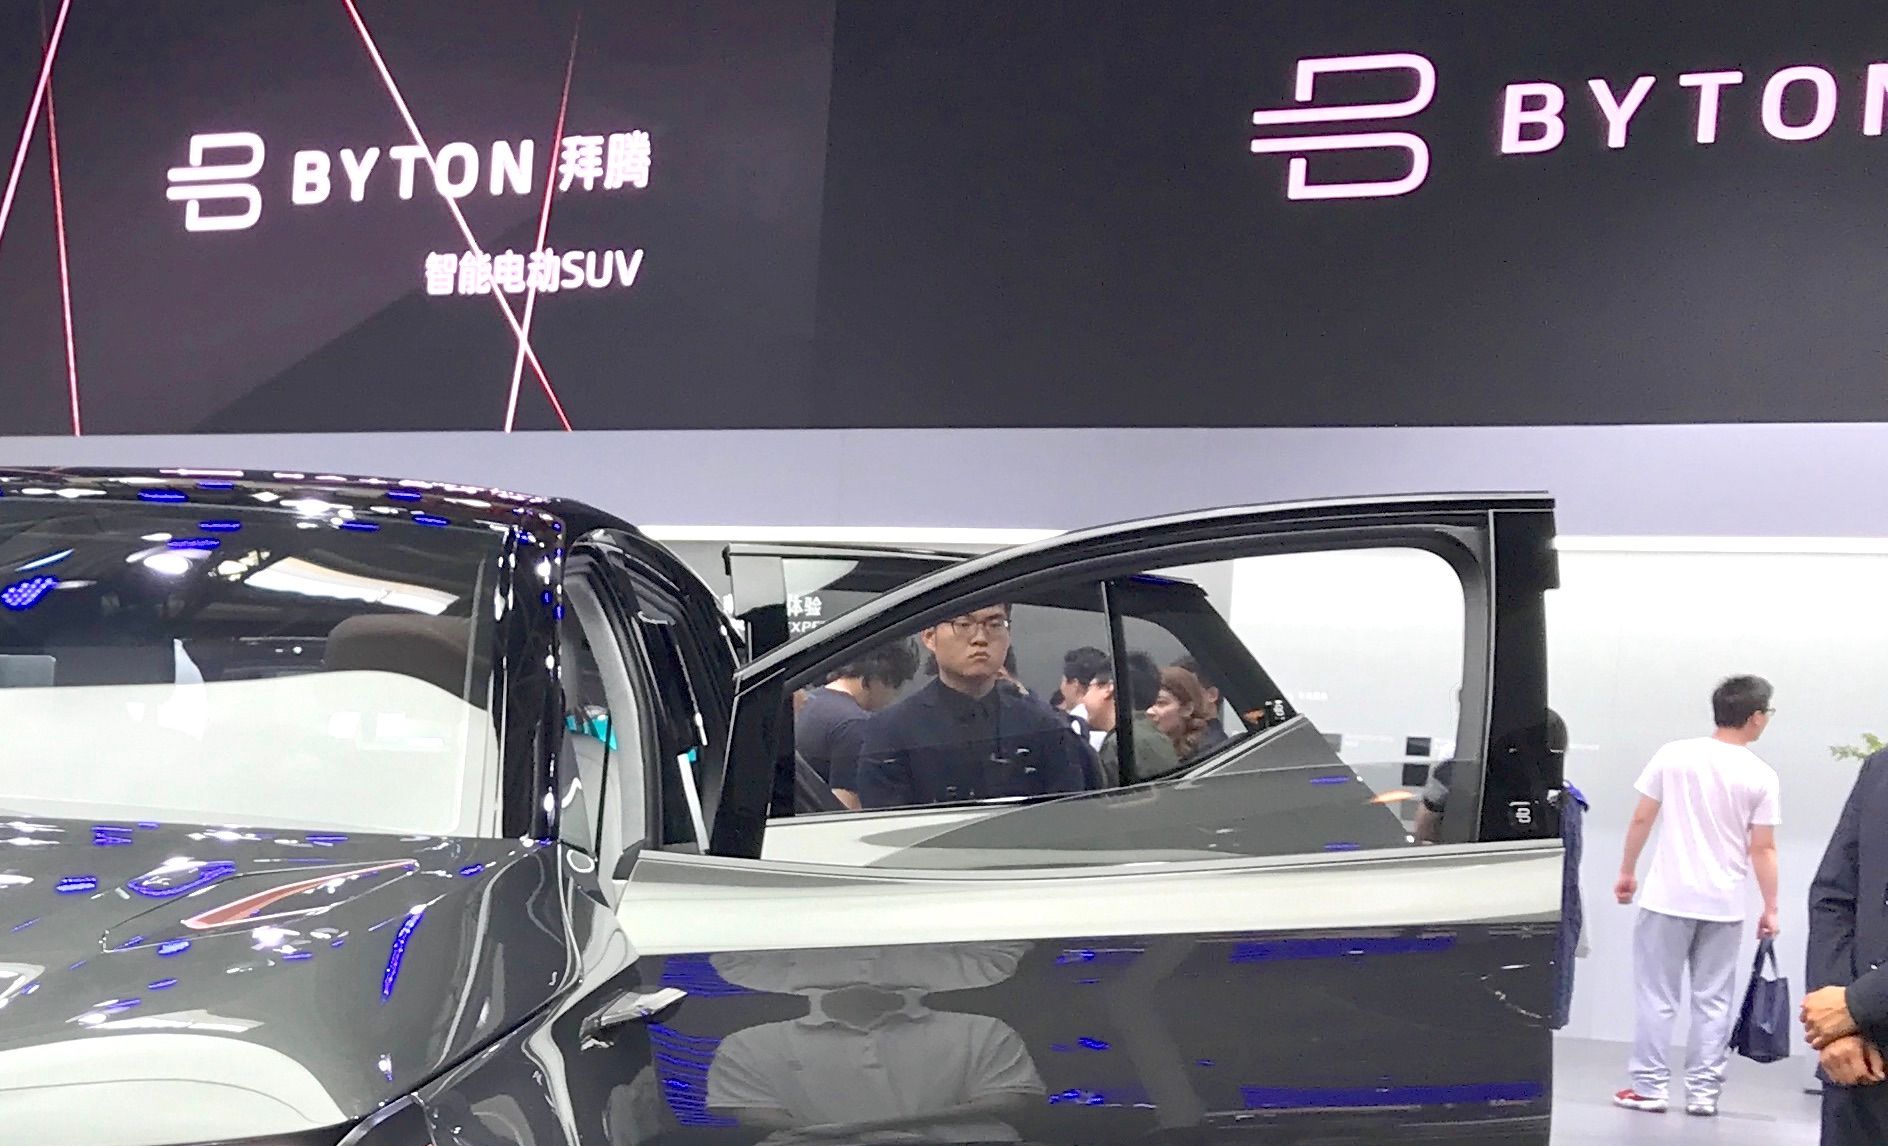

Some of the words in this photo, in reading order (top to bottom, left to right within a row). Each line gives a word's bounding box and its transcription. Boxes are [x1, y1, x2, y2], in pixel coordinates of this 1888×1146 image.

[292, 138, 535, 205] BYTON
[557, 129, 652, 192] 拜腾
[424, 248, 644, 297] 智能电动SUV
